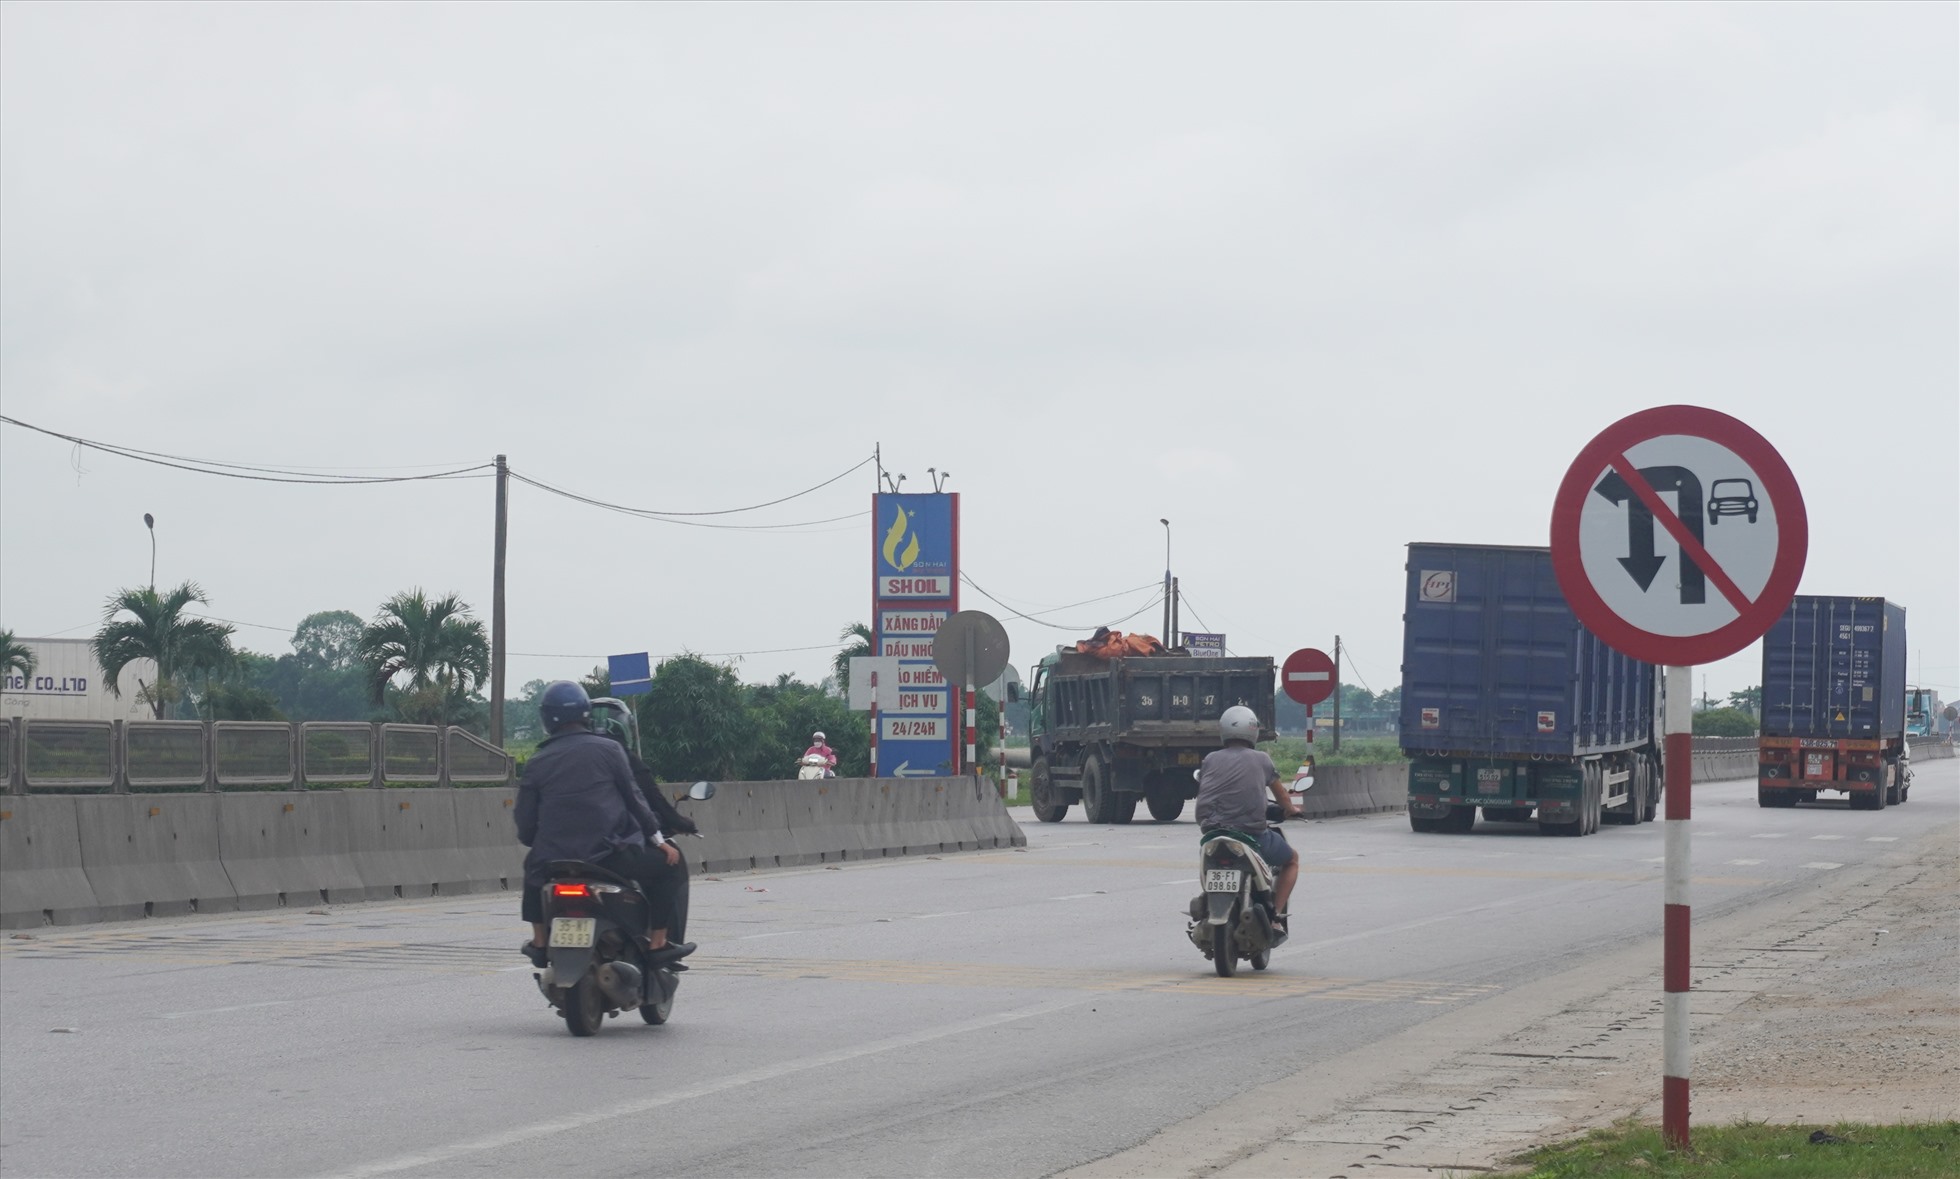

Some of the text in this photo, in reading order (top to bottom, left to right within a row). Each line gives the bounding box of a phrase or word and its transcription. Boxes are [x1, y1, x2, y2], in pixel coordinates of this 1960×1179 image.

[885, 614, 919, 631] XĂNG
[922, 694, 938, 711] VỤ
[892, 721, 936, 736] 24/24H
[1211, 871, 1235, 881] 36-F1
[1207, 882, 1237, 891] 098.66
